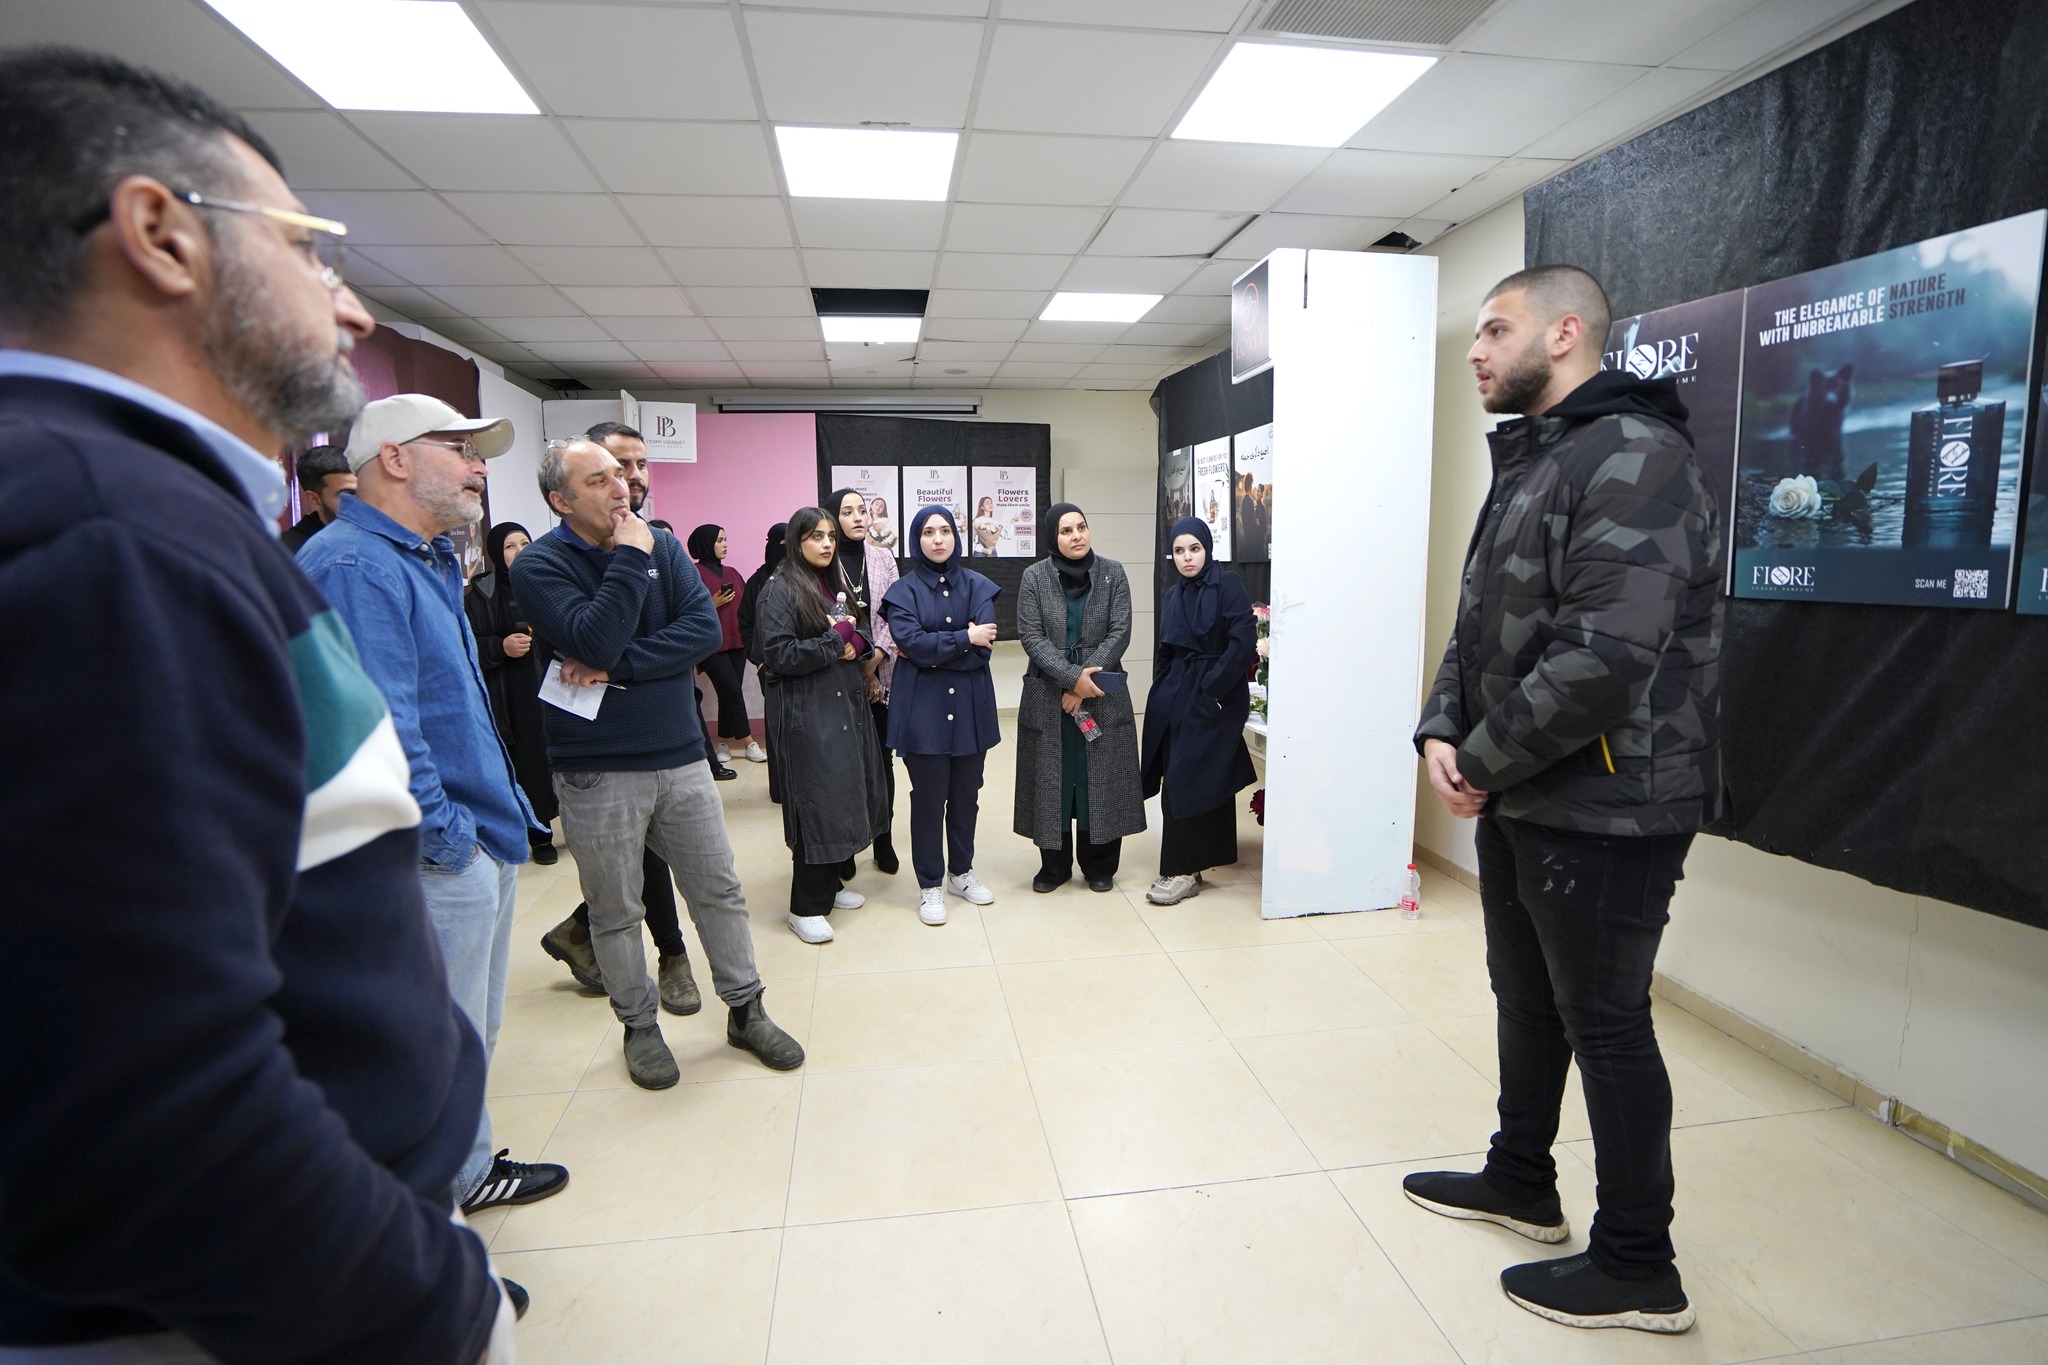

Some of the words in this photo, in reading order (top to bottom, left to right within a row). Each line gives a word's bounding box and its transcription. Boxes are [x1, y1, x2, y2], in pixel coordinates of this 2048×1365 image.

[1775, 307, 1797, 327] THE
[1800, 291, 1864, 322] ELEGANCE
[1868, 287, 1886, 307] OF
[1889, 273, 1947, 301] NATURE
[1759, 326, 1790, 346] WITH
[1793, 305, 1885, 339] UNBREAKABLE
[1889, 288, 1966, 319] STRENGTH
[1937, 416, 1973, 498] FIORE
[1209, 463, 1225, 474] FLOWERS
[916, 488, 953, 496] Beautiful
[1752, 566, 1815, 586] FIORE
[1915, 578, 1935, 589] SCAN
[1936, 578, 1948, 589] ME
